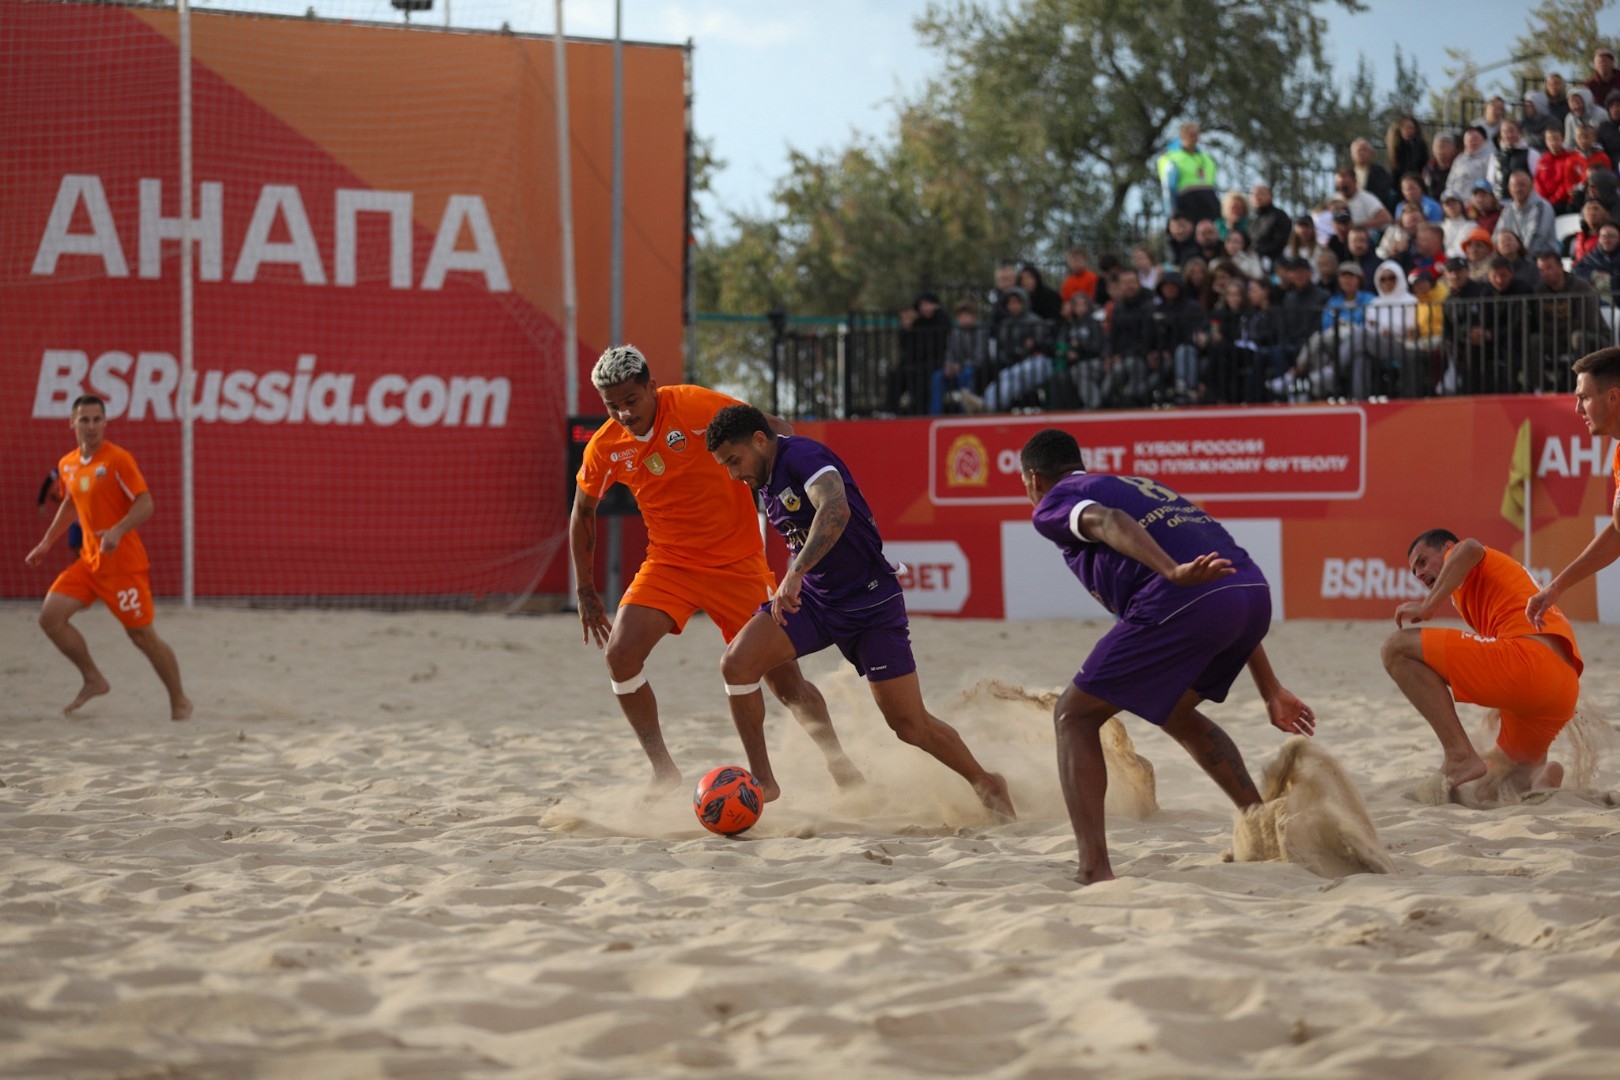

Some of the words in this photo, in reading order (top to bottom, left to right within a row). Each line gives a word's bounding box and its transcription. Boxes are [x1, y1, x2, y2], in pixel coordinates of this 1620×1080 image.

[31, 173, 513, 293] АНАПА
[32, 349, 512, 428] BSRussia.com
[1134, 440, 1190, 457] КУБОК
[1192, 438, 1264, 456] РОССИИ
[1133, 458, 1159, 475] ПО
[1161, 456, 1263, 475] ПЛЯЖНОМУ
[1264, 454, 1349, 473] ФУТБОЛУ
[1117, 475, 1178, 503] 8
[116, 587, 142, 612] 22
